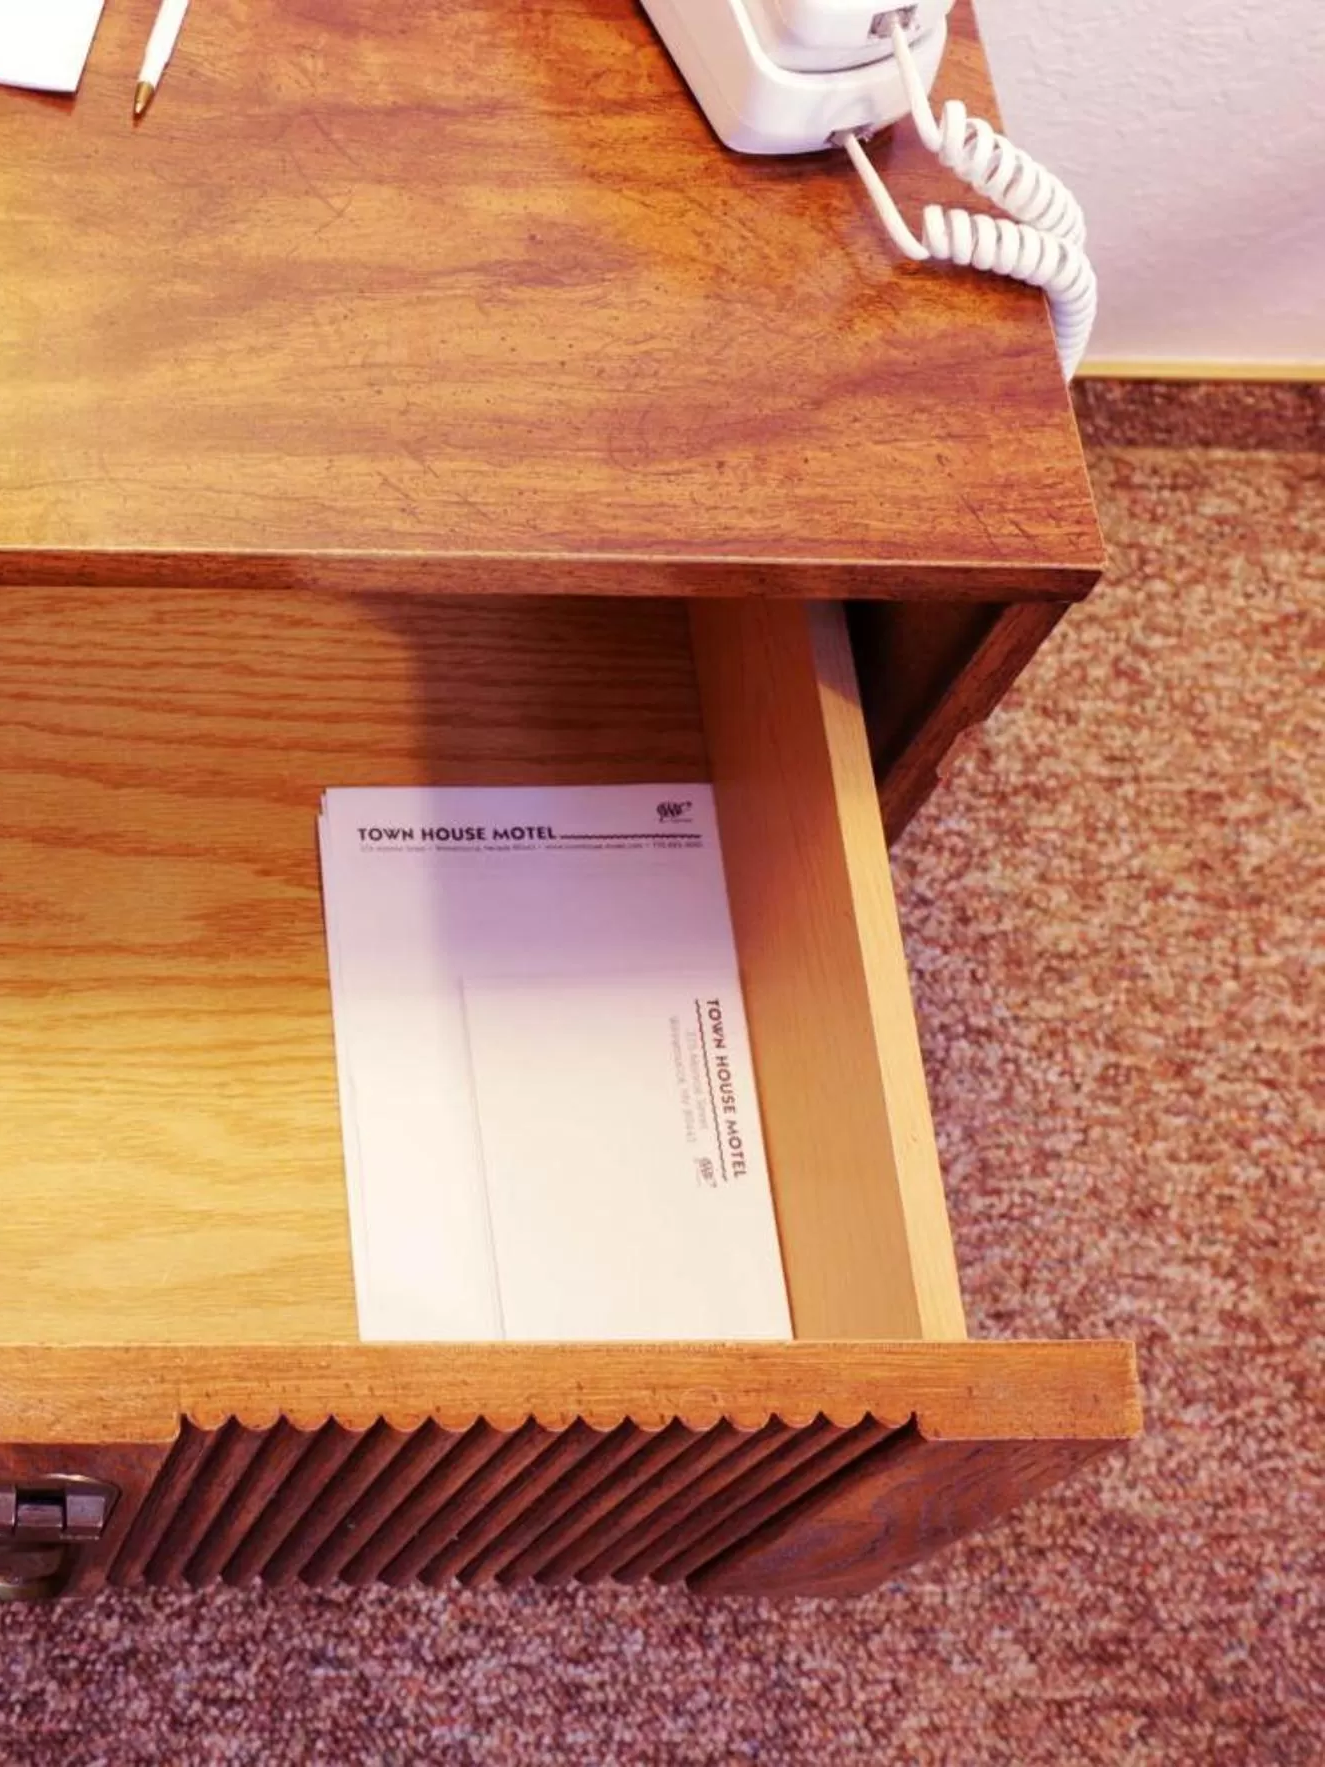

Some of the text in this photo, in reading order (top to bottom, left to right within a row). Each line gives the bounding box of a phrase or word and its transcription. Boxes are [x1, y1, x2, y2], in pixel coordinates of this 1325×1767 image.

[358, 826, 557, 841] TOWN HOUSE MOTEL
[707, 999, 747, 1179] TOWN HOUSE MOTEL
